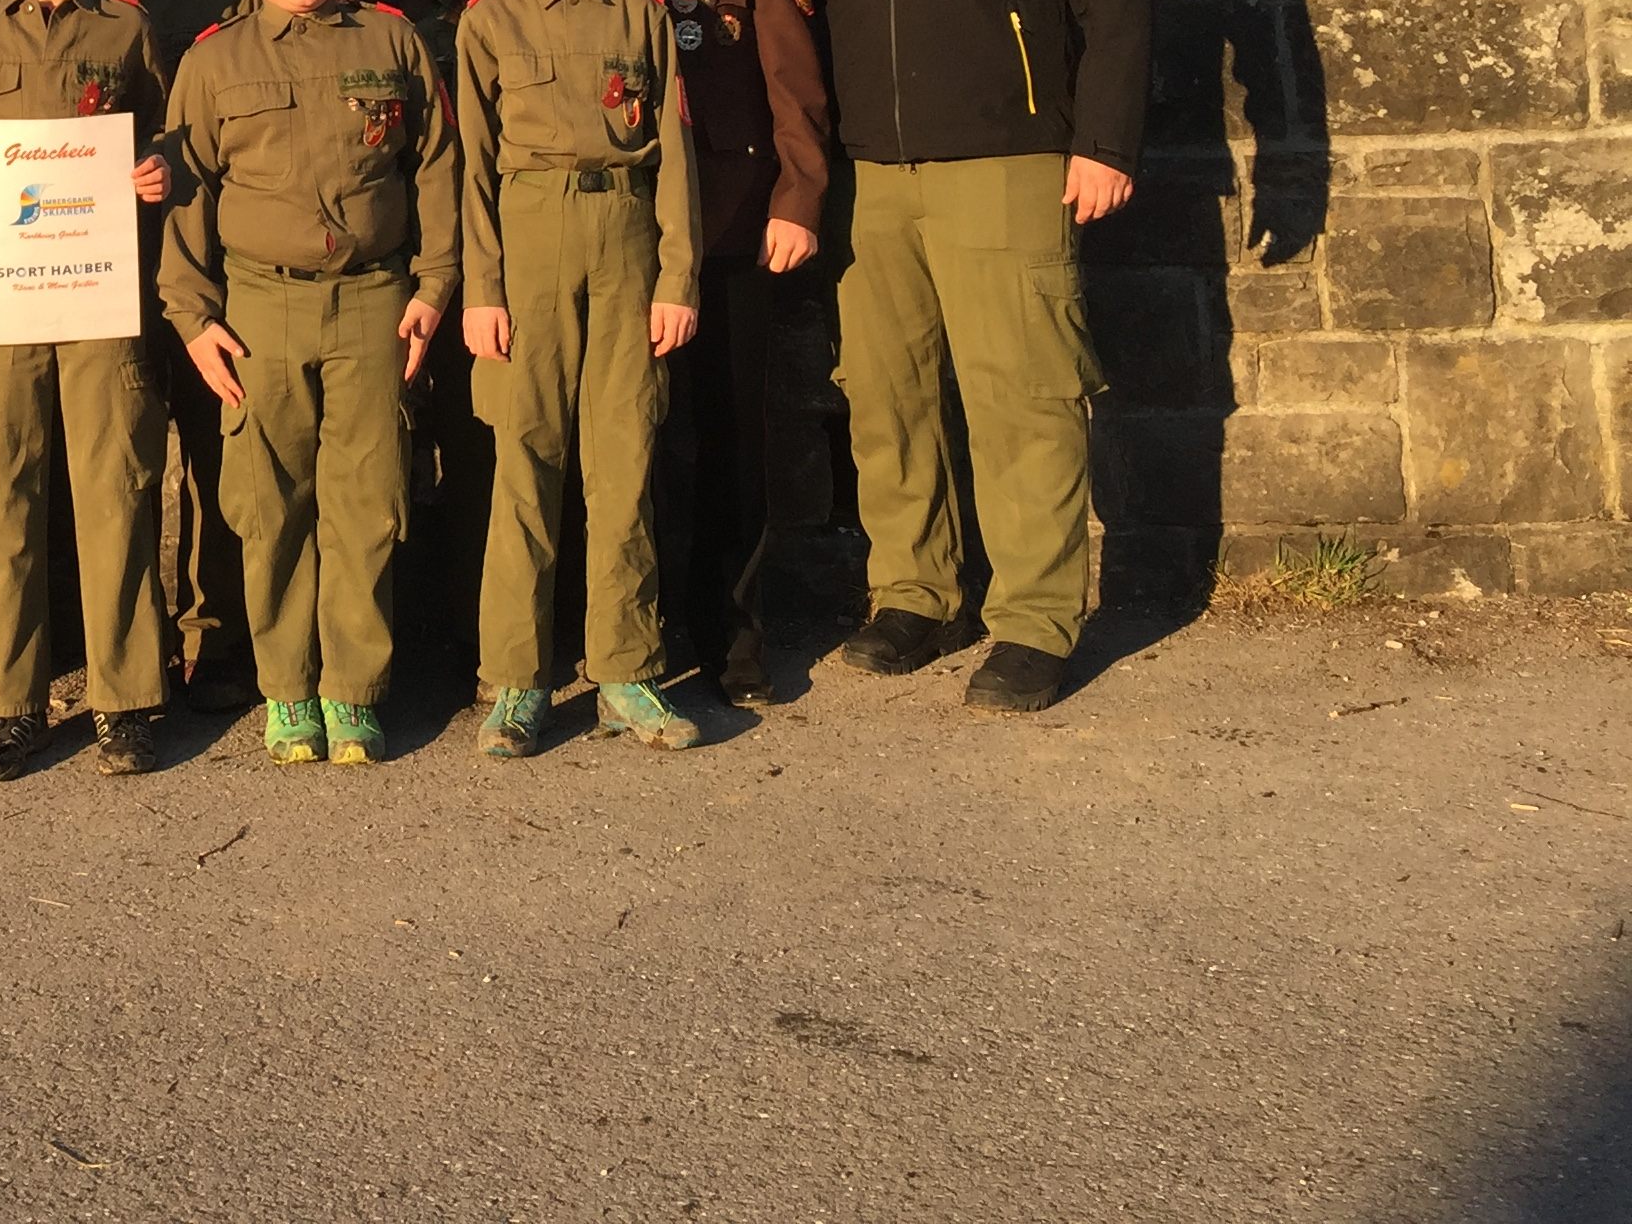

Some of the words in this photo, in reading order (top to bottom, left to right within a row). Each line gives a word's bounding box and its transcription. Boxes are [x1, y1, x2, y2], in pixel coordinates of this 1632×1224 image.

[4, 142, 97, 166] Gutschein
[42, 206, 95, 217] SKIARENA
[51, 261, 113, 276] HAUBER
